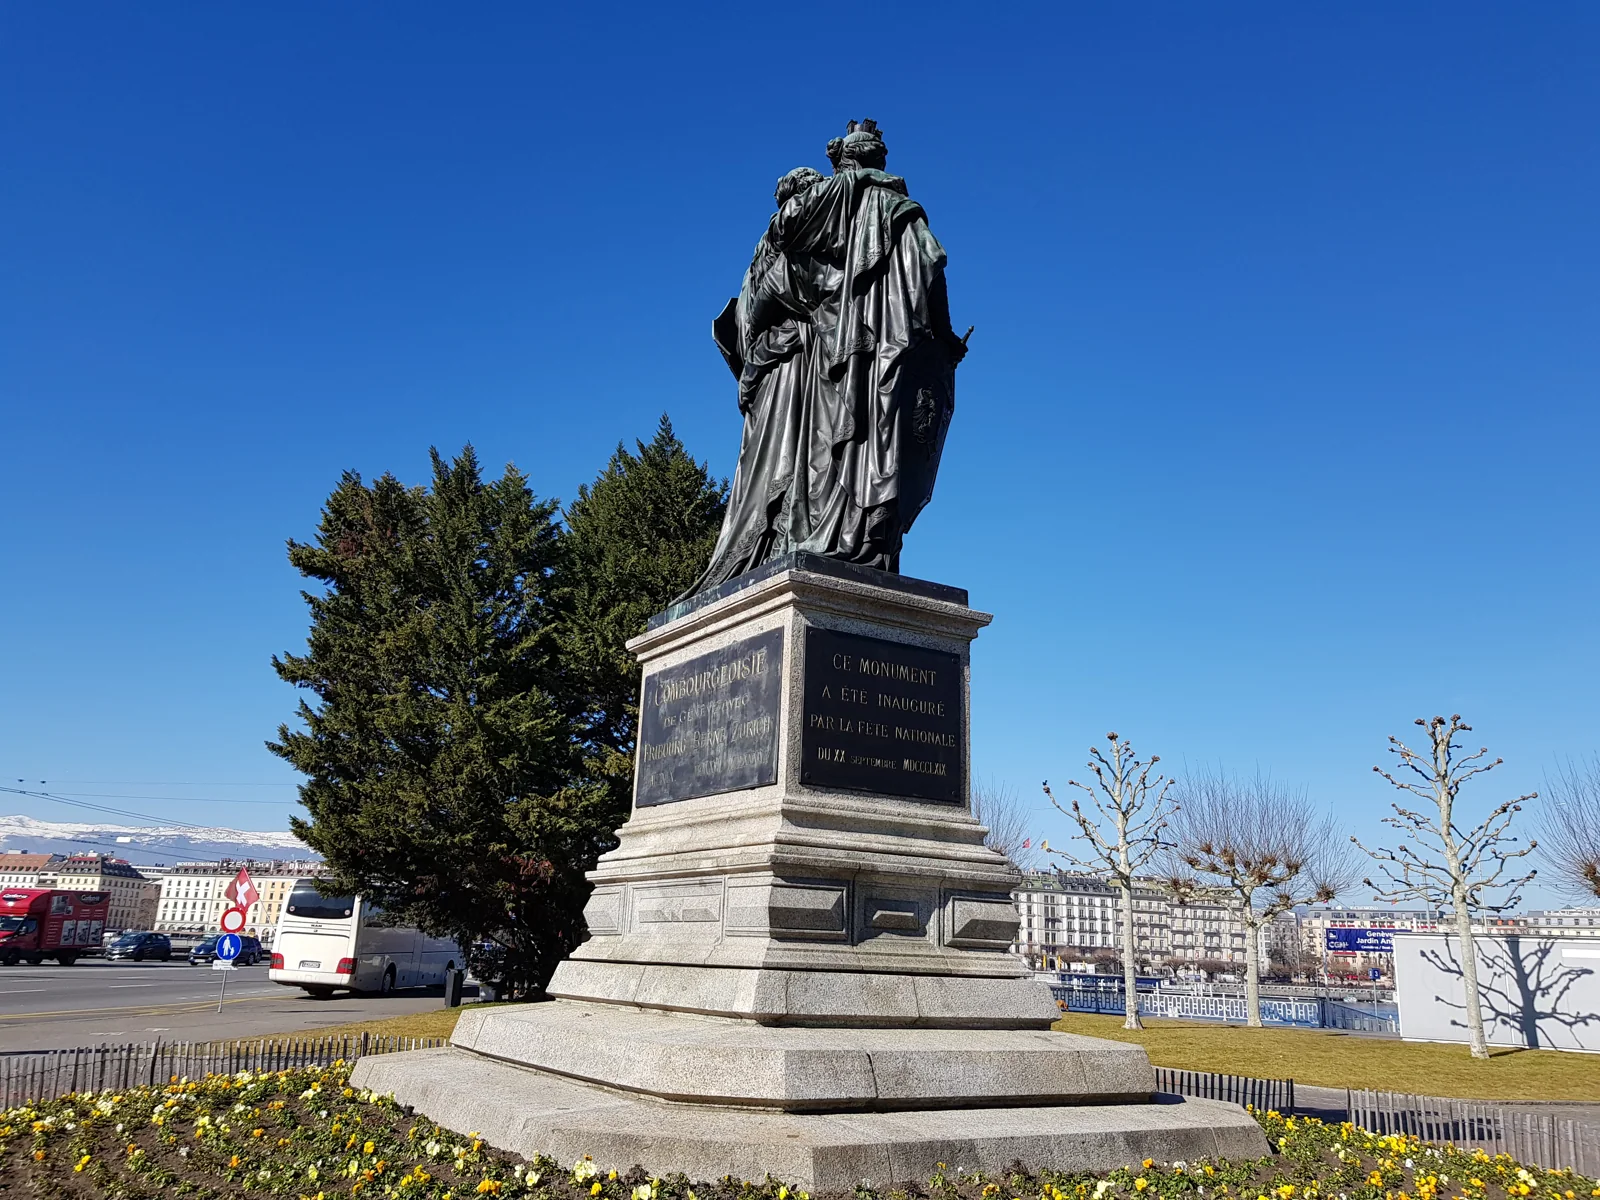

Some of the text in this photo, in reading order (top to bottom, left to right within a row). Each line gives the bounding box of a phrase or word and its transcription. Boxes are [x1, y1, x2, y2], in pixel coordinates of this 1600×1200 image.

[654, 652, 767, 707] COMBOURGEOISIE
[833, 653, 937, 686] CE MONUMENT
[822, 685, 945, 717] A ÉTÉ INAUGURÉ
[810, 714, 835, 731] PAR
[839, 717, 854, 733] LA
[894, 726, 956, 748] NATIONALE
[644, 738, 687, 763] FRIBOURG
[818, 747, 947, 776] DU XX SEPTEMBRE MDCCCLXIX
